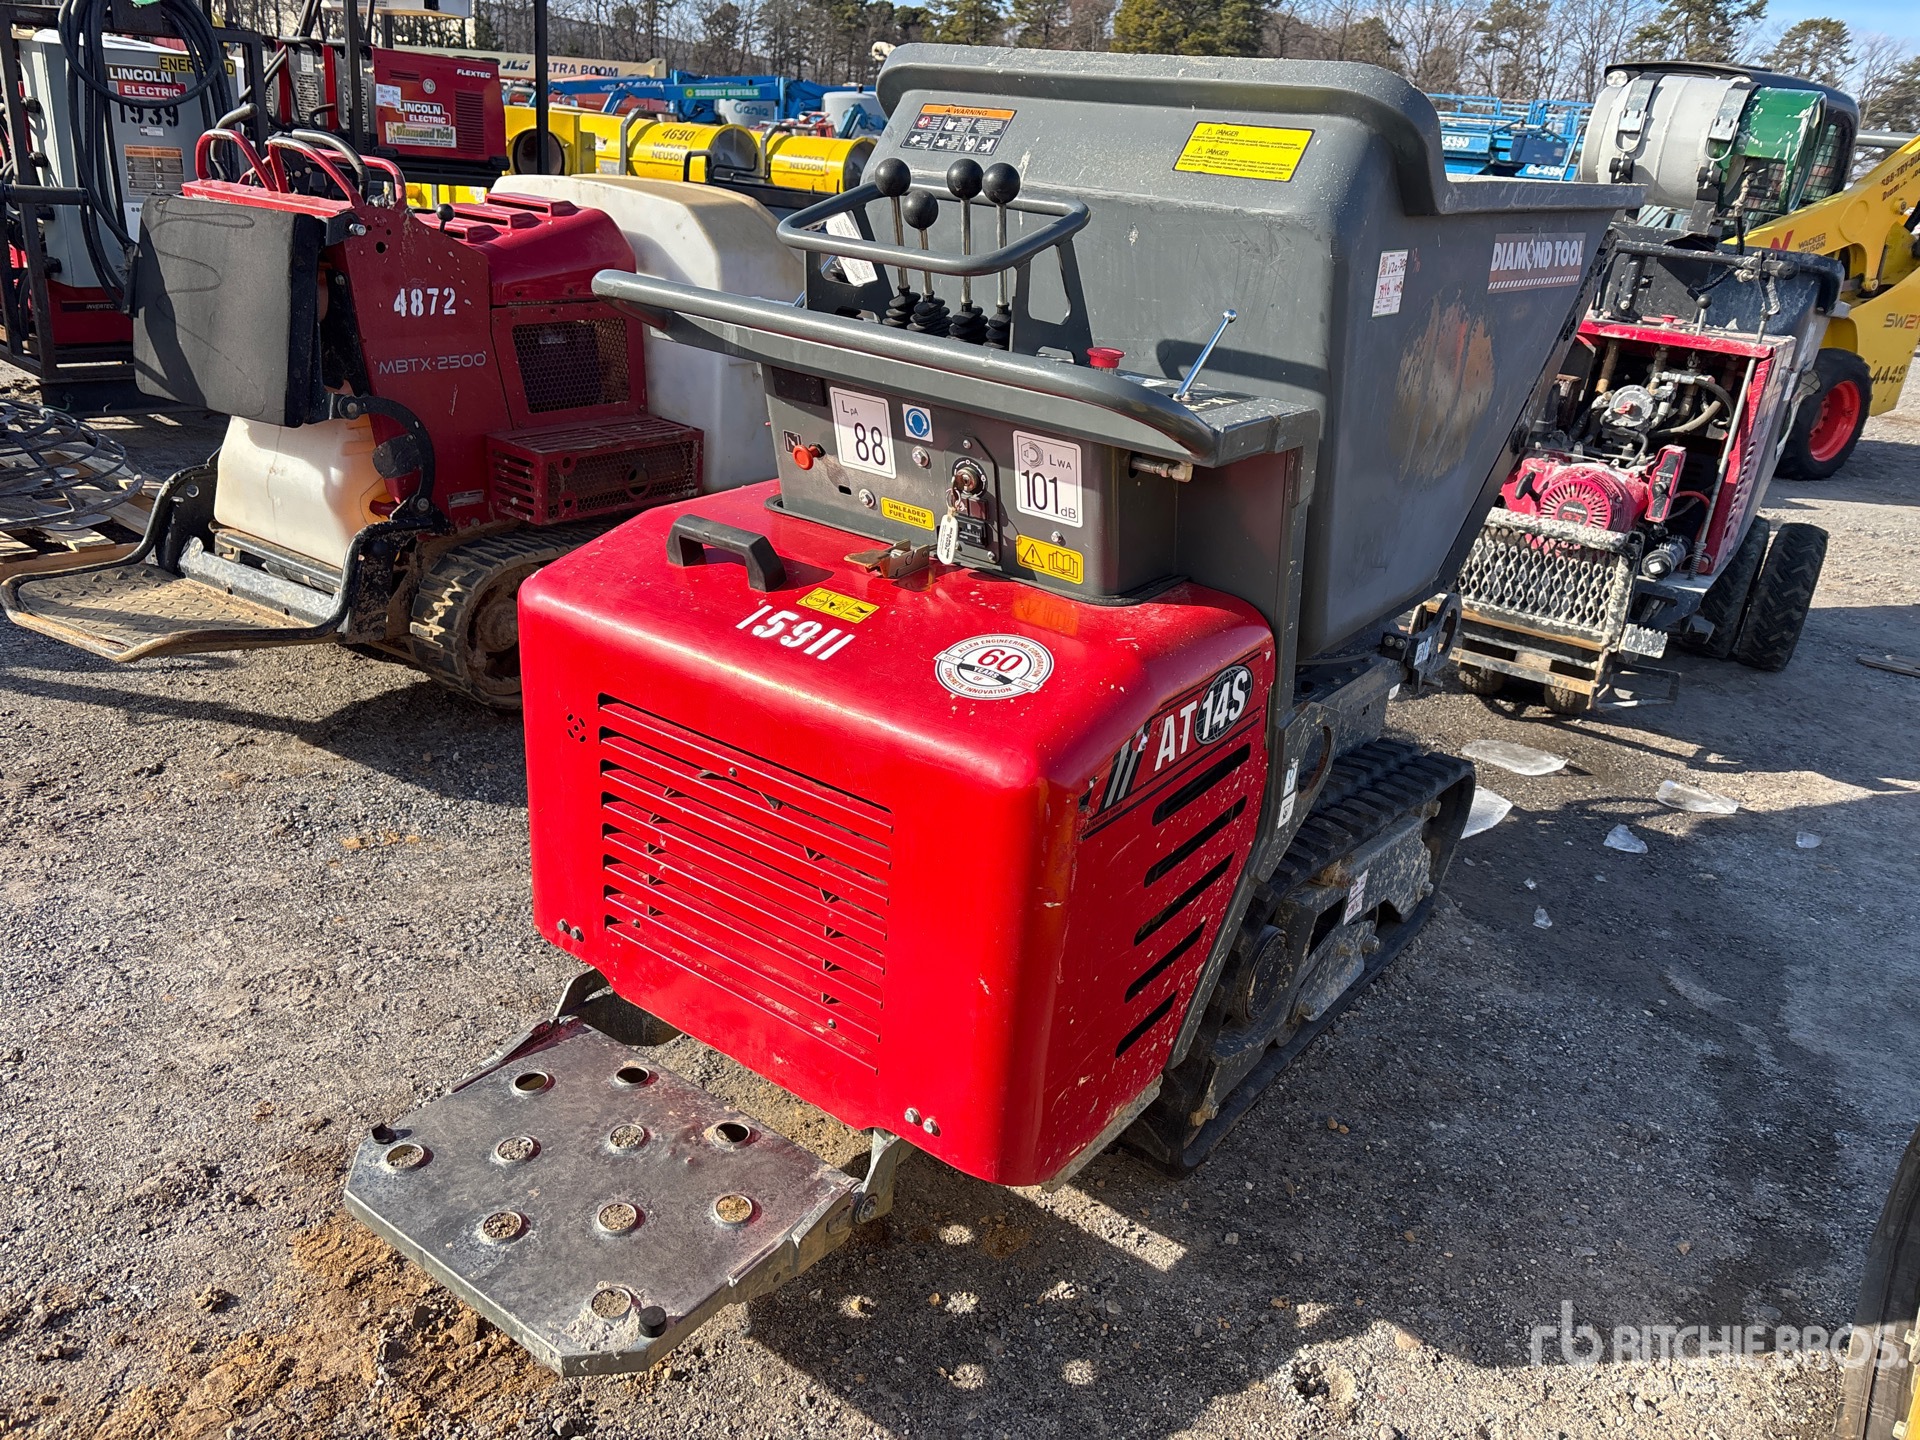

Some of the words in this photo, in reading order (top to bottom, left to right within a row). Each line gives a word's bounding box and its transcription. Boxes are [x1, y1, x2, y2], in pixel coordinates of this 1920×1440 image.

[109, 67, 172, 83] LINCOLN
[456, 68, 491, 78] FLEXTEC
[547, 62, 577, 74] LTRA
[581, 64, 619, 77] BOOM
[124, 85, 181, 98] ELECTRIC
[694, 88, 726, 97] SUNBELT
[727, 88, 759, 97] RENTALS
[734, 102, 769, 116] Genie
[408, 114, 447, 124] ELECTRIC
[396, 125, 435, 139] Diamond
[436, 127, 454, 140] Tool
[661, 128, 696, 142] 4690
[1215, 129, 1240, 137] DANGER
[1205, 148, 1230, 156] DANGER
[1798, 232, 1827, 250] WACKER
[1799, 240, 1827, 254] EUSON
[1554, 240, 1583, 267] TOOL
[393, 287, 457, 318] 4872
[853, 422, 886, 466] 88
[1020, 469, 1060, 516] 101
[1060, 507, 1078, 520] dB
[888, 502, 927, 518] UNLEADED
[889, 509, 907, 519] FUEL
[908, 515, 927, 525] ONLY
[735, 604, 856, 661] 15911
[957, 641, 980, 654] ALLEN
[981, 638, 1030, 649] ENGINEERING
[1028, 647, 1044, 678] CORPORATION
[977, 648, 1023, 673] 60
[973, 666, 1000, 679] YEARS
[944, 667, 966, 690] CONCRETE
[965, 686, 1013, 695] INNOVATION
[1154, 699, 1198, 772] AT
[1202, 669, 1249, 740] 14S
